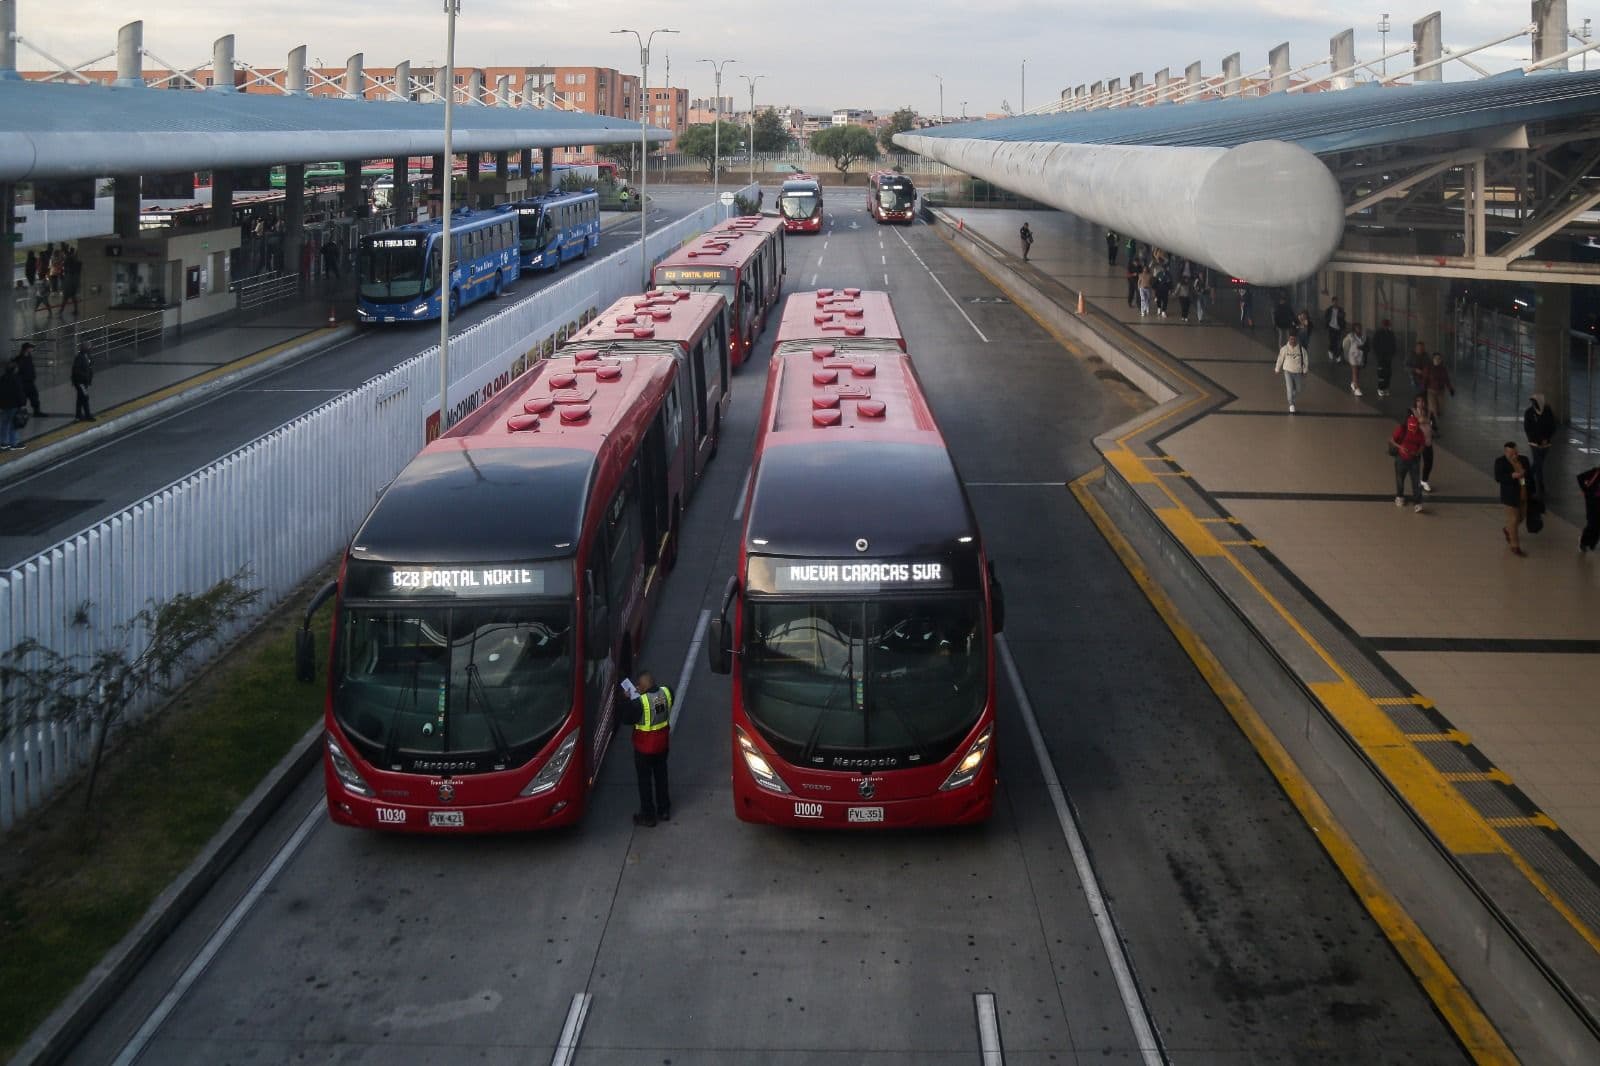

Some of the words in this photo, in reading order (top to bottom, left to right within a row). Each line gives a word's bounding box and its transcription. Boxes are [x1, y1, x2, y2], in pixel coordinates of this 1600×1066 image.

[422, 570, 480, 587] PORTAL
[483, 568, 532, 586] NORTE
[790, 565, 838, 581] NUEVA
[841, 563, 909, 581] CARACAS
[912, 563, 942, 580] SUR
[413, 760, 477, 770] Marcopolo
[833, 757, 897, 768] Marcopolo
[802, 783, 832, 791] VOLVO
[376, 808, 407, 821] T1030
[794, 802, 823, 816] U1009
